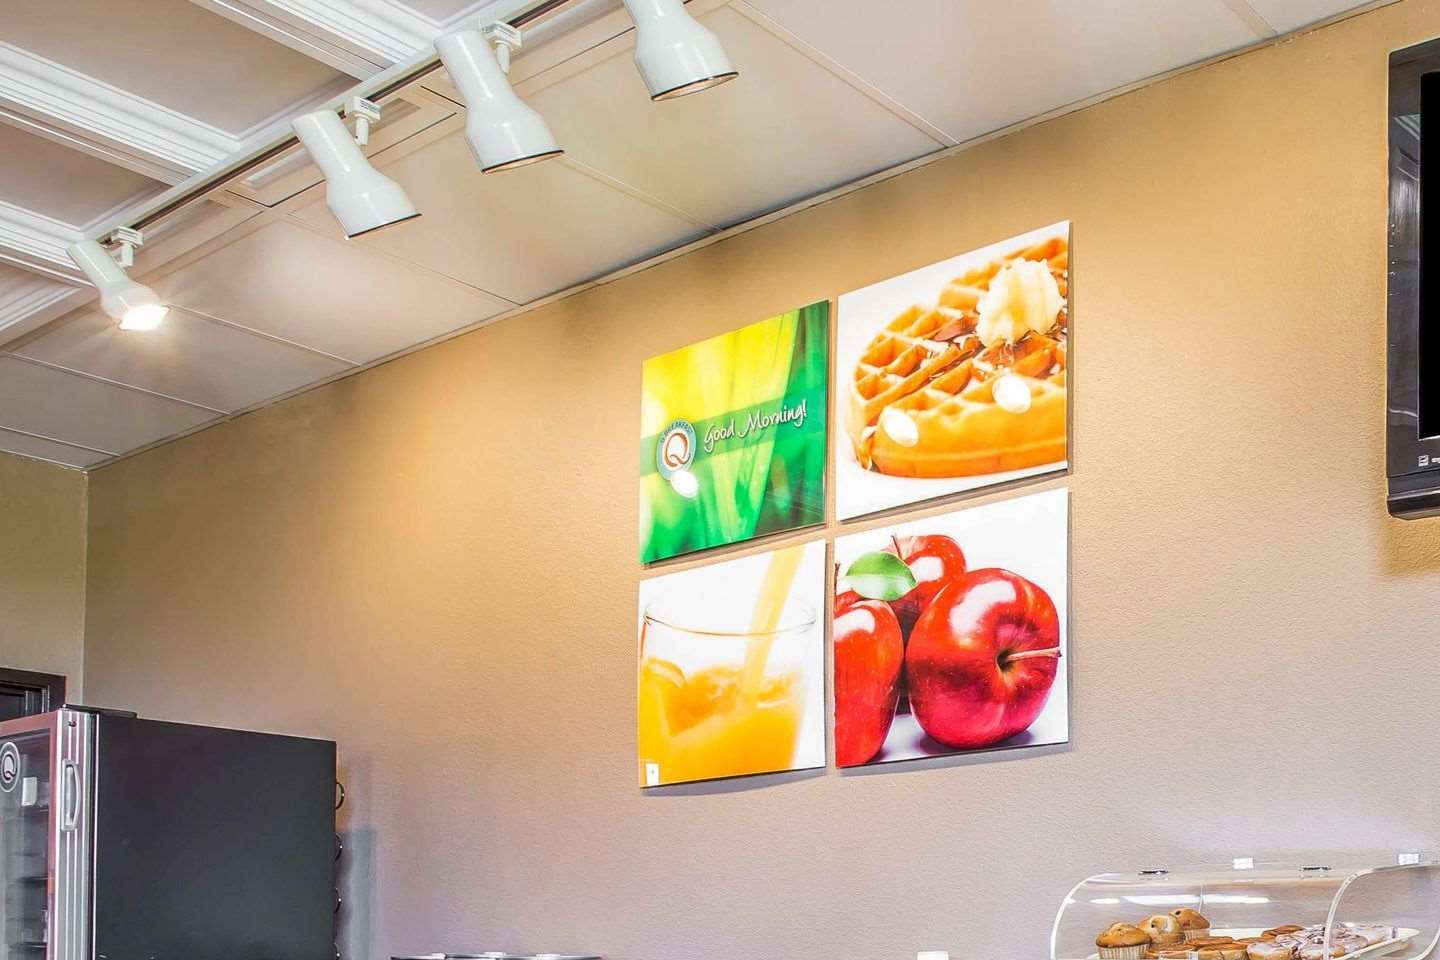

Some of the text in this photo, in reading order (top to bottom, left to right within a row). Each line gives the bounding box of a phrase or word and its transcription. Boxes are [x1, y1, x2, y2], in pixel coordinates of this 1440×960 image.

[704, 418, 735, 453] Good
[738, 398, 807, 438] Morning!
[665, 432, 691, 468] Q
[3, 753, 17, 781] Q
